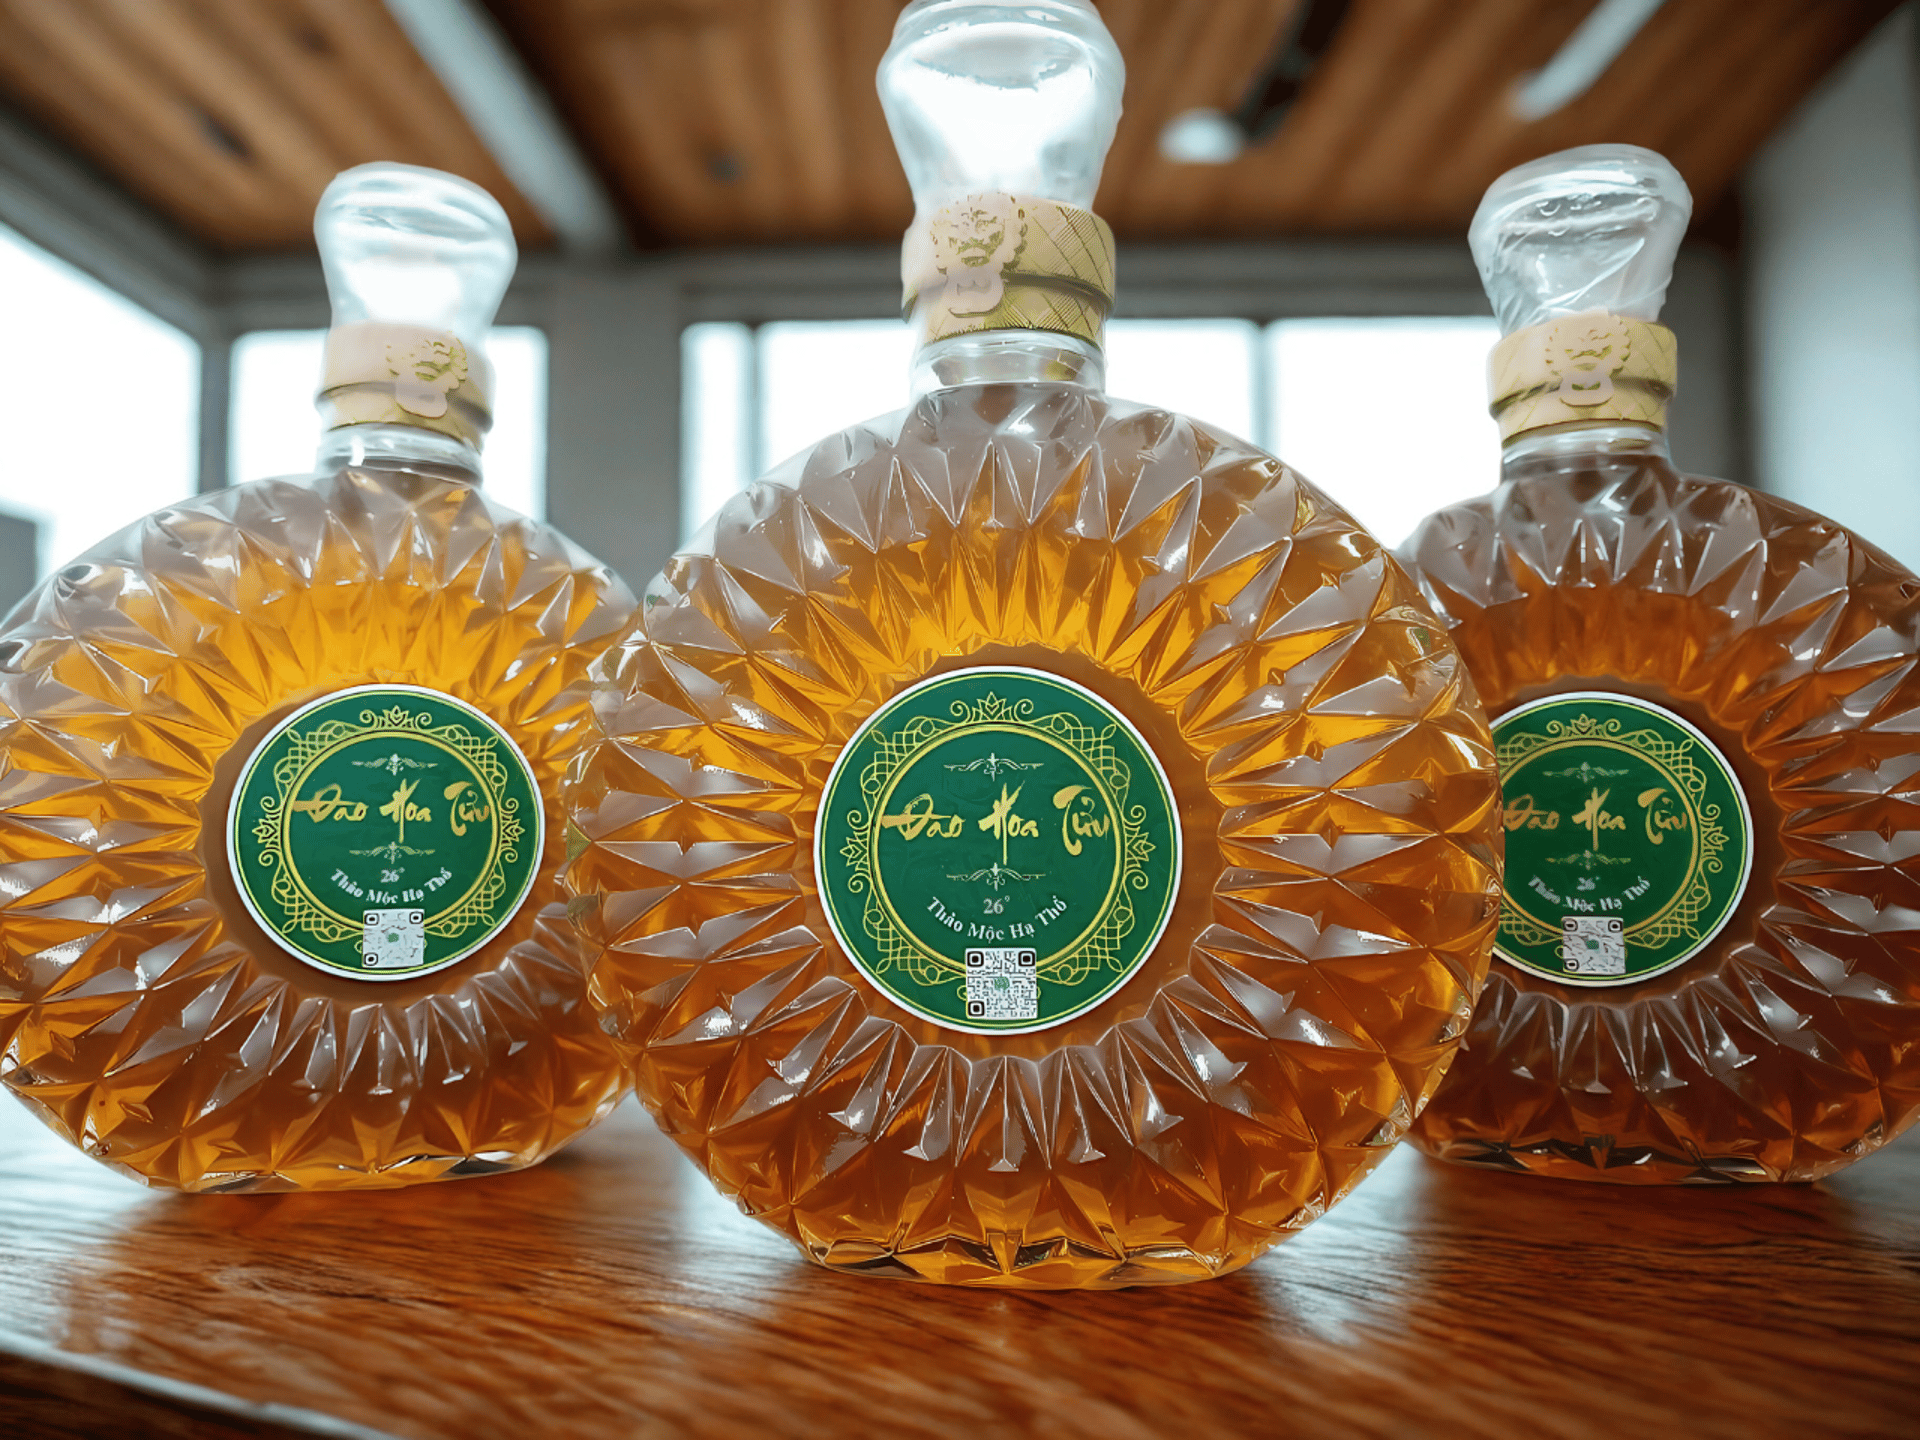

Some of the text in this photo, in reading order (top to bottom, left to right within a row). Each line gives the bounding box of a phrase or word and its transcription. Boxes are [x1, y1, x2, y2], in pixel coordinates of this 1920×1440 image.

[379, 778, 432, 843] Hoa
[978, 780, 1039, 866] Hoa
[1572, 786, 1626, 852] Hoa
[927, 896, 963, 932] Thảo
[967, 922, 1005, 944] Mộc
[1009, 922, 1035, 938] Hạ
